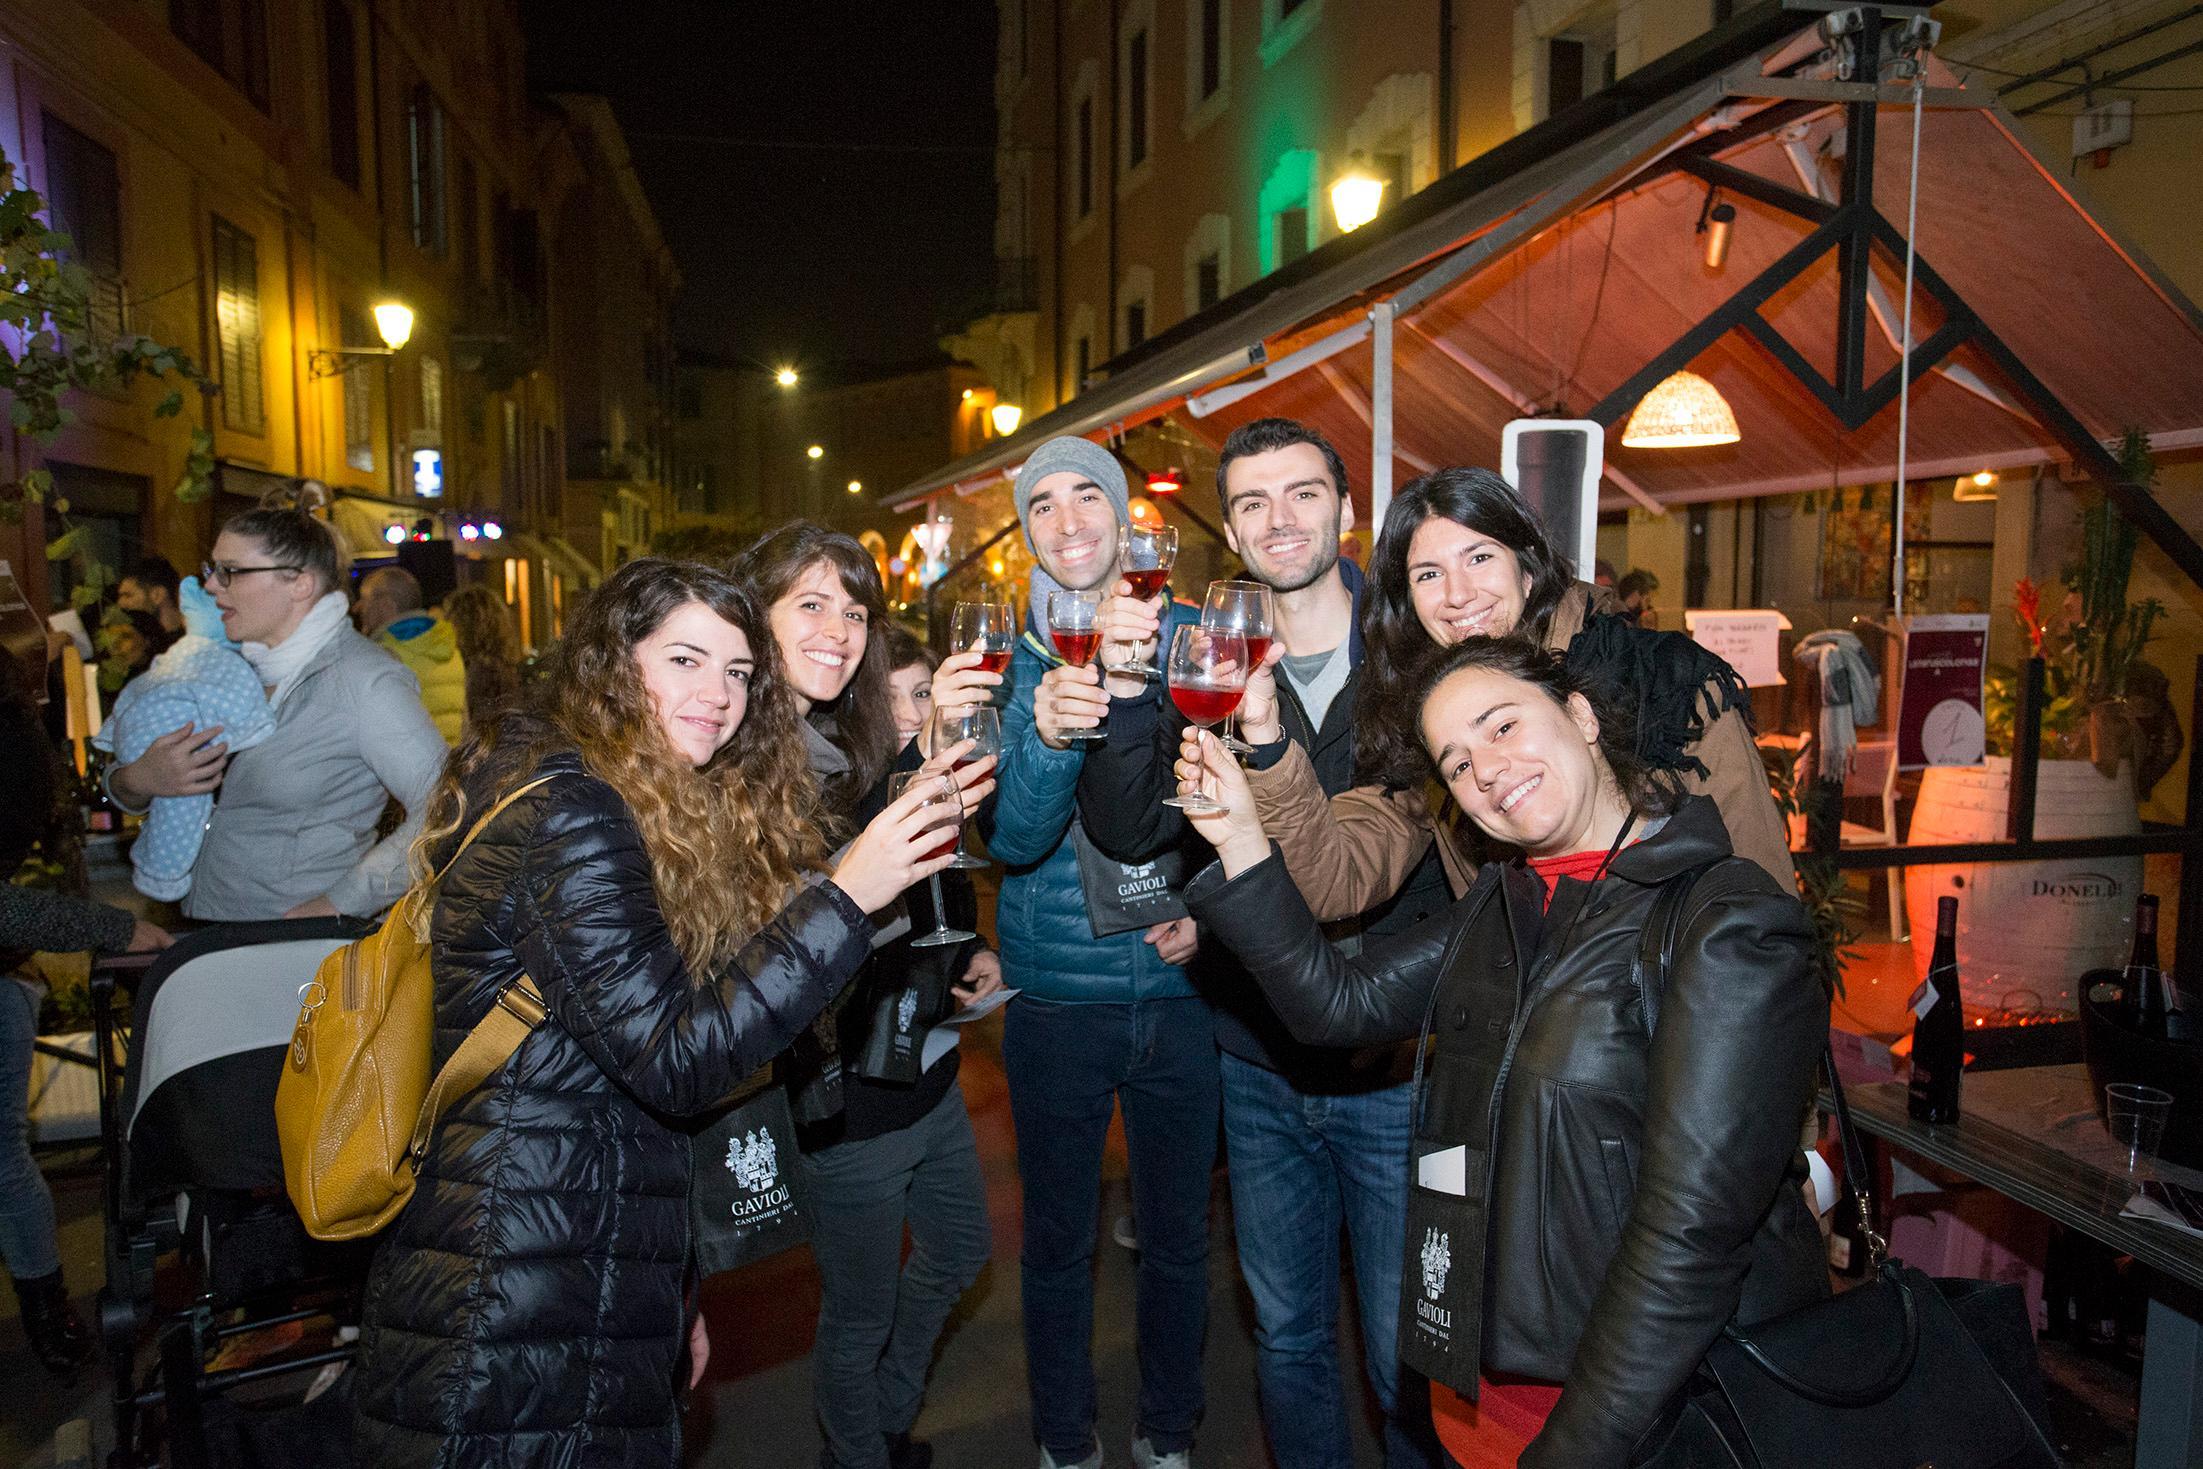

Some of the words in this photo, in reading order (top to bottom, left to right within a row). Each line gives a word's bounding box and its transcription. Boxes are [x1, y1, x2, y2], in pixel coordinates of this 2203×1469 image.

[1118, 876, 1167, 896] GAVIOLI
[732, 1184, 790, 1216] GAVIOLI
[735, 1208, 780, 1226] CANTINIERI
[1417, 1298, 1451, 1328] GAVIOLI
